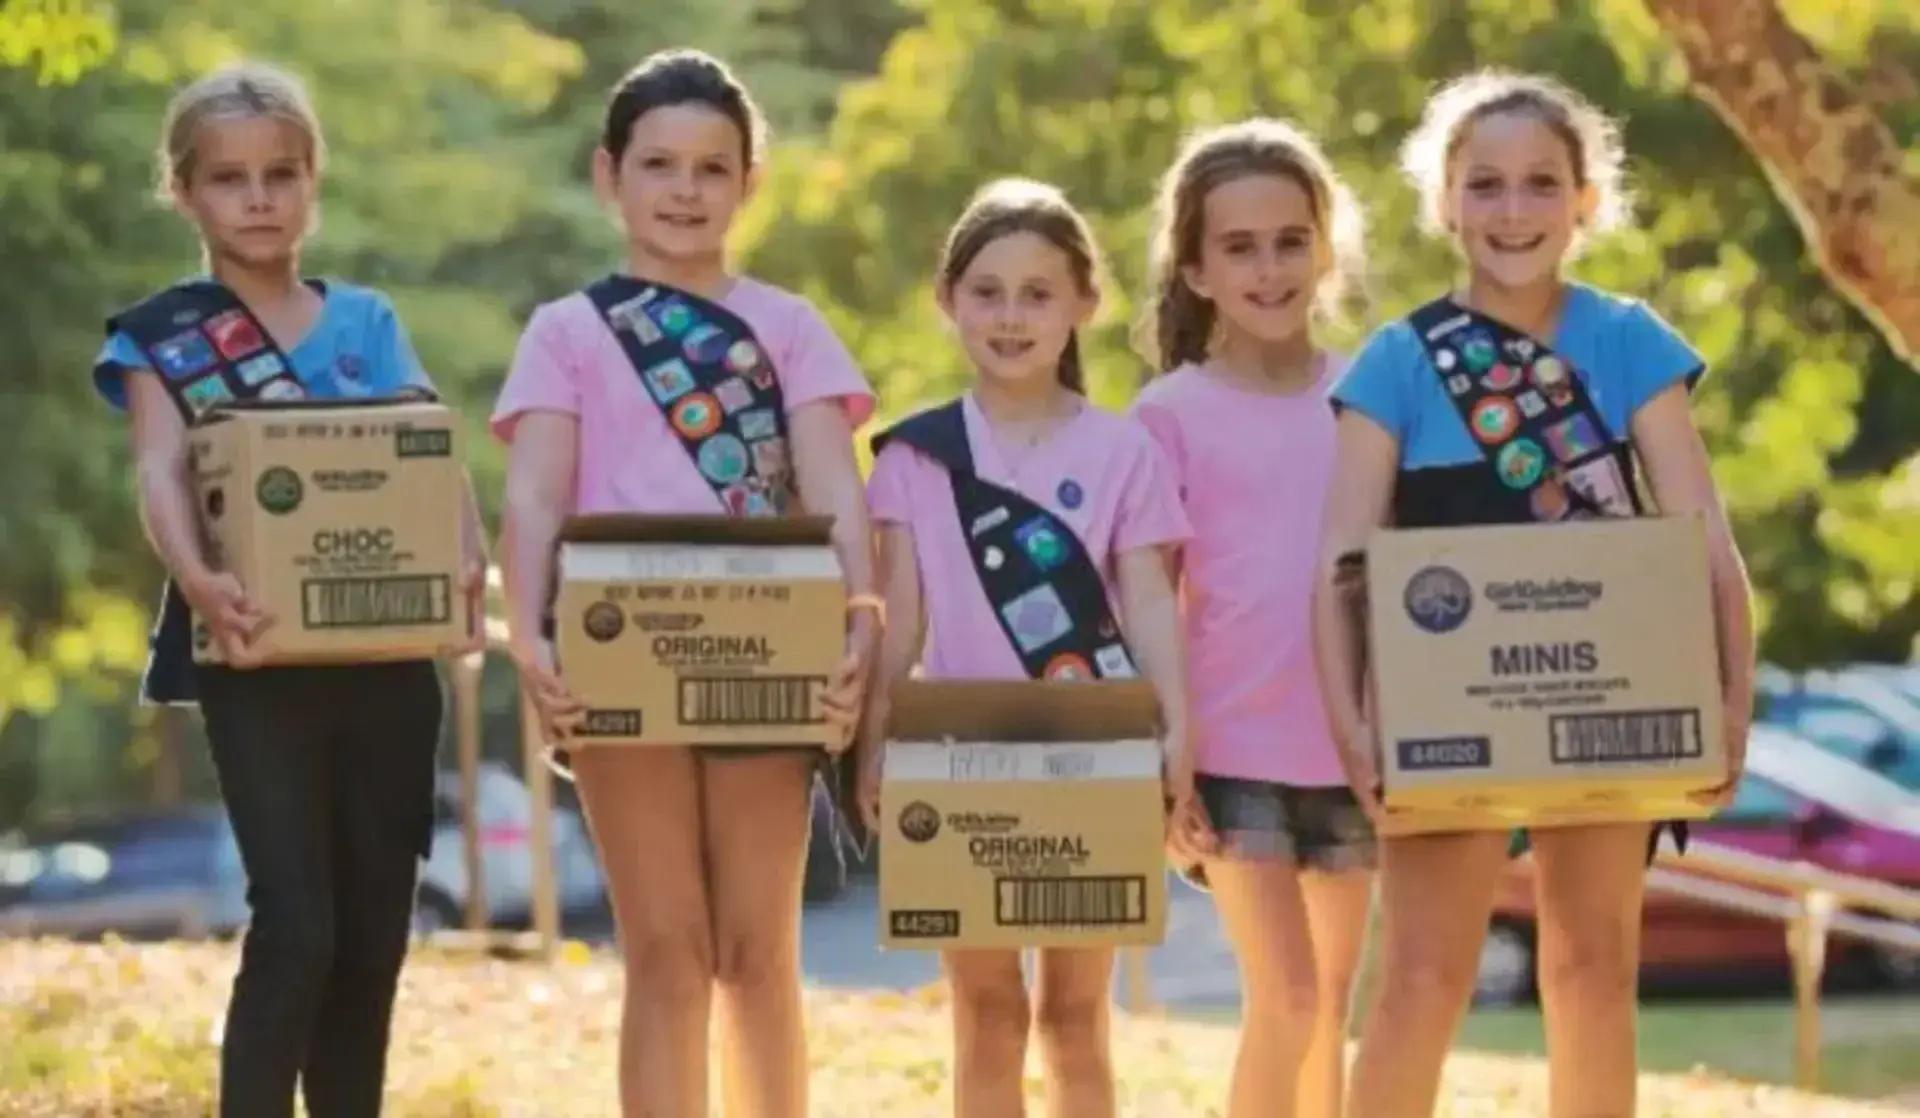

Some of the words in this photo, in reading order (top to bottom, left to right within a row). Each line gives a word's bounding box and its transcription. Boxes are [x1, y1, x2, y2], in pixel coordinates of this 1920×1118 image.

[313, 529, 395, 554] CHOC
[652, 636, 770, 657] ORIGINAL
[1490, 642, 1599, 675] MINIS
[969, 836, 1091, 859] ORIGINAL
